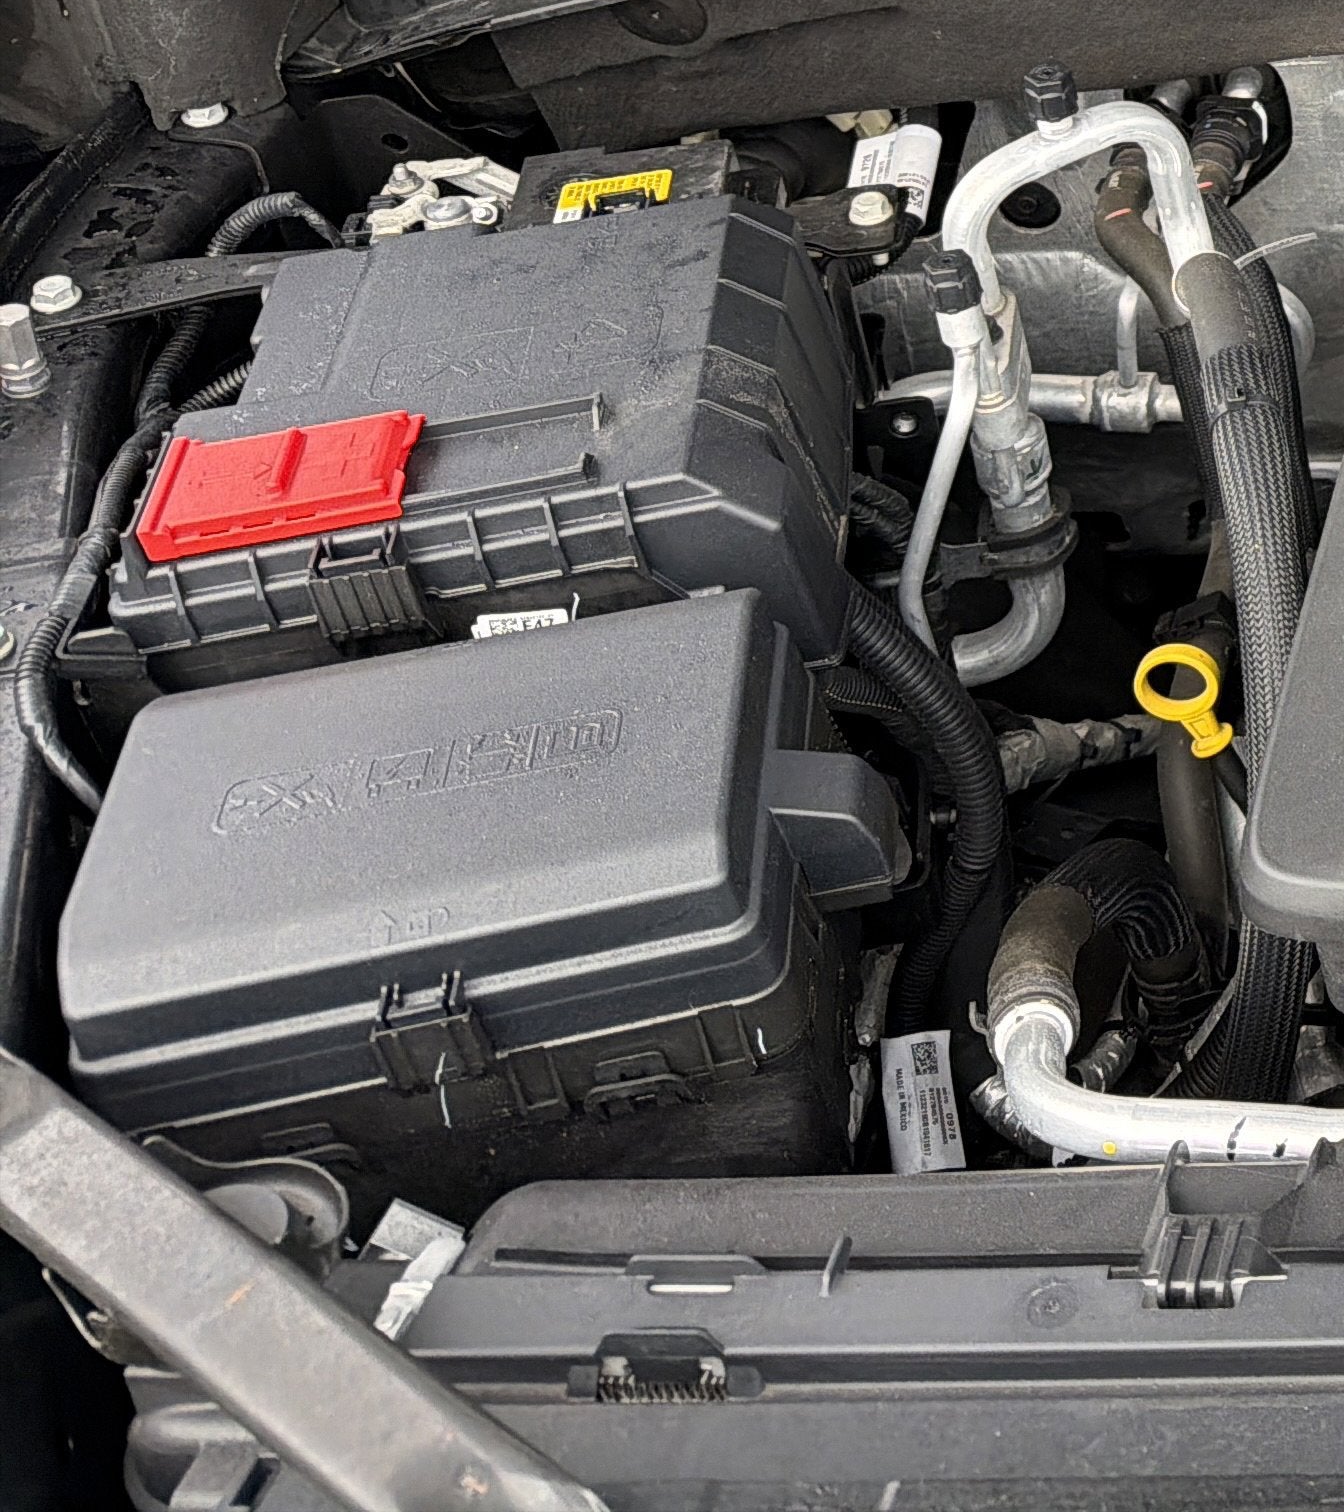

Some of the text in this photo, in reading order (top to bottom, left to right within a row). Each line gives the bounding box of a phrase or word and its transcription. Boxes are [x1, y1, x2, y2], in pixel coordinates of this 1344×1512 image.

[895, 1068, 908, 1131] MADE IN MEXICO
[945, 1112, 957, 1141] 0978
